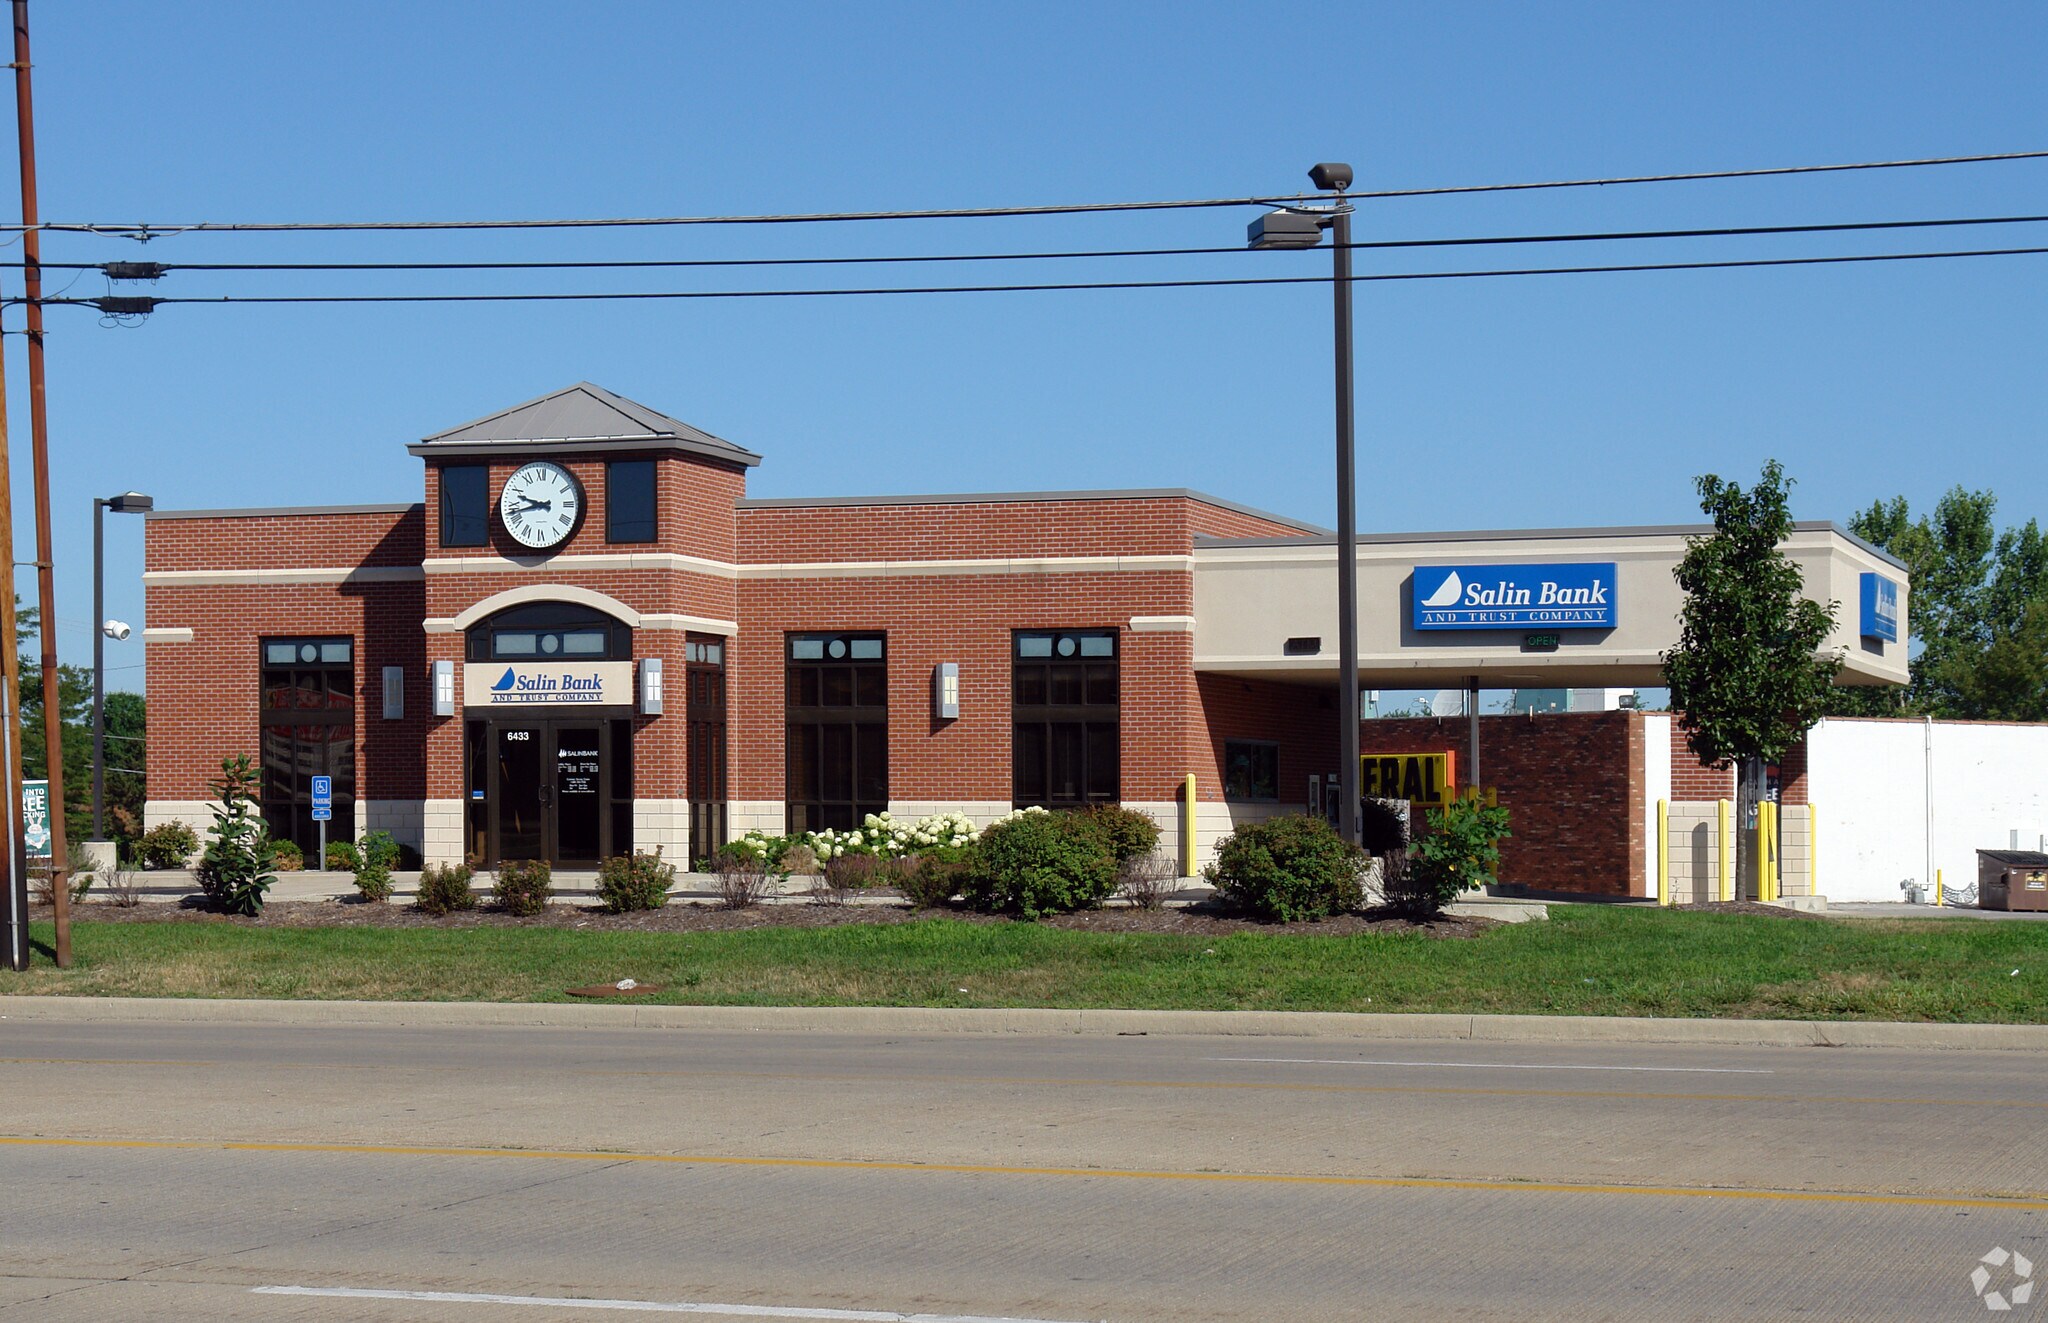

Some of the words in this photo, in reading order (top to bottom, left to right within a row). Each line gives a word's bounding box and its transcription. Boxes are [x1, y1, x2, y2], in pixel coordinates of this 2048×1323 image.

[1464, 581, 1531, 607] Salin
[1537, 579, 1608, 605] Bank
[1425, 613, 1457, 622] AND
[1469, 612, 1517, 621] TRUST
[1529, 611, 1605, 621] COMPANY
[1528, 636, 1557, 646] OPEN
[516, 674, 557, 691] Salin
[561, 673, 603, 690] Bank
[493, 694, 513, 702] AND
[555, 693, 602, 701] COMPANY
[507, 731, 529, 741] 6433
[1363, 756, 1441, 803] ERAL
[25, 788, 45, 796] INTO
[23, 796, 45, 812] REE
[23, 811, 46, 819] CKING
